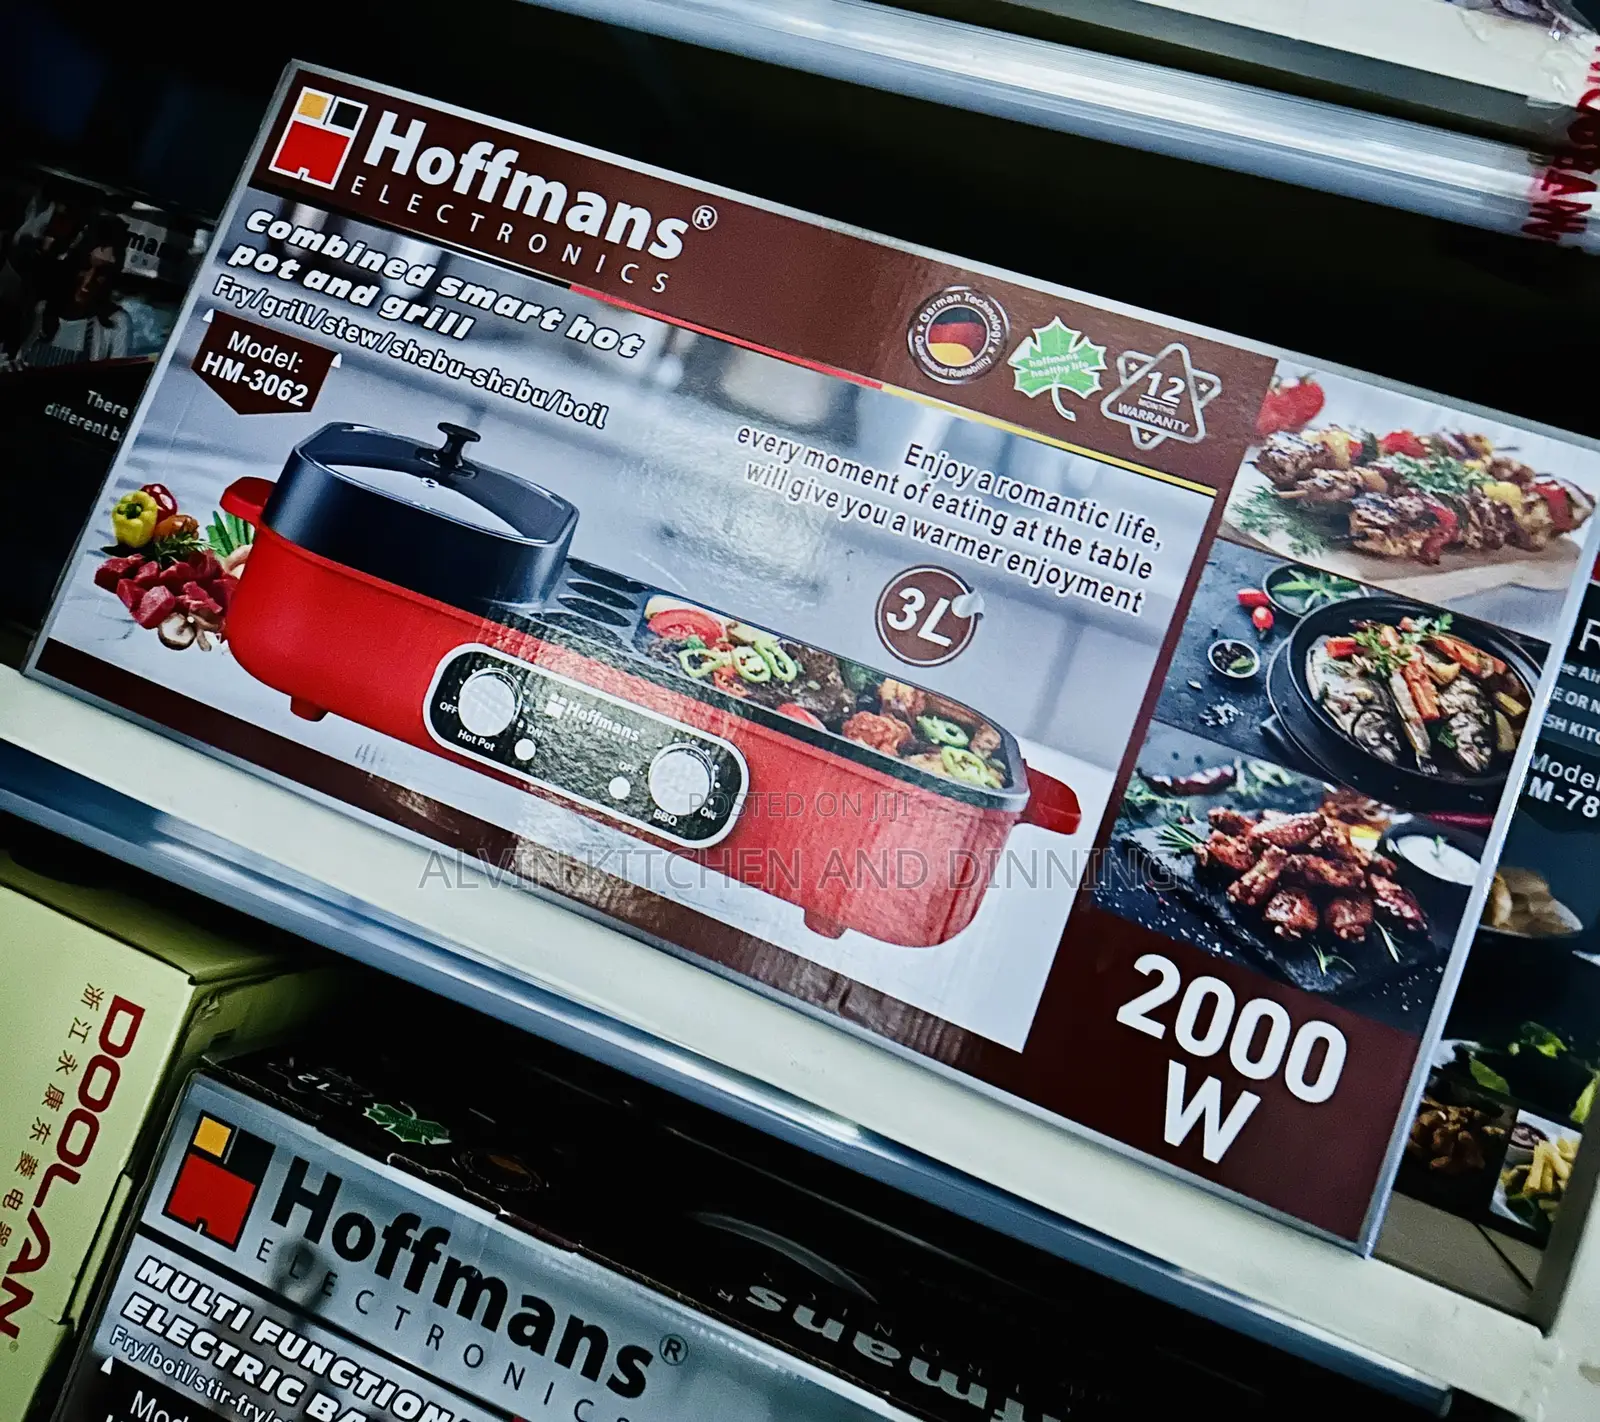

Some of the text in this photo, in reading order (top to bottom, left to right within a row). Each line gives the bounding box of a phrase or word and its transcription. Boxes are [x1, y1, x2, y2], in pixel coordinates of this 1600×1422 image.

[350, 175, 670, 295] ELECTRONICS
[227, 244, 476, 340] pot and grill
[435, 275, 566, 331] smart
[564, 314, 645, 358] hot
[200, 351, 309, 407] HM-3062
[212, 274, 609, 429] Fry/grill/stew/shabu-shabu/boil
[226, 330, 304, 374] Model:
[1030, 360, 1090, 378] healthy life
[1147, 371, 1186, 403] 12
[44, 402, 109, 437] different
[87, 389, 129, 419] There
[1118, 402, 1190, 433] WARRANTY
[737, 427, 1152, 580] every moment of eating at the table
[904, 442, 1161, 551] Enjoy a romantic life,
[747, 463, 1142, 613] will give you a warmer enjoyment
[886, 585, 956, 649] 3L
[439, 701, 459, 715] OFF
[457, 728, 496, 752] Hot Pot
[564, 700, 640, 742] Hoffmans
[652, 808, 678, 827] BBQ
[1115, 953, 1348, 1104] 2000
[1163, 1059, 1262, 1164] W
[0, 994, 146, 1340] DOOLAN
[136, 1256, 253, 1333] MULTI
[255, 1238, 630, 1422] ELECTRONIC
[122, 1292, 307, 1406] ELECTRIC
